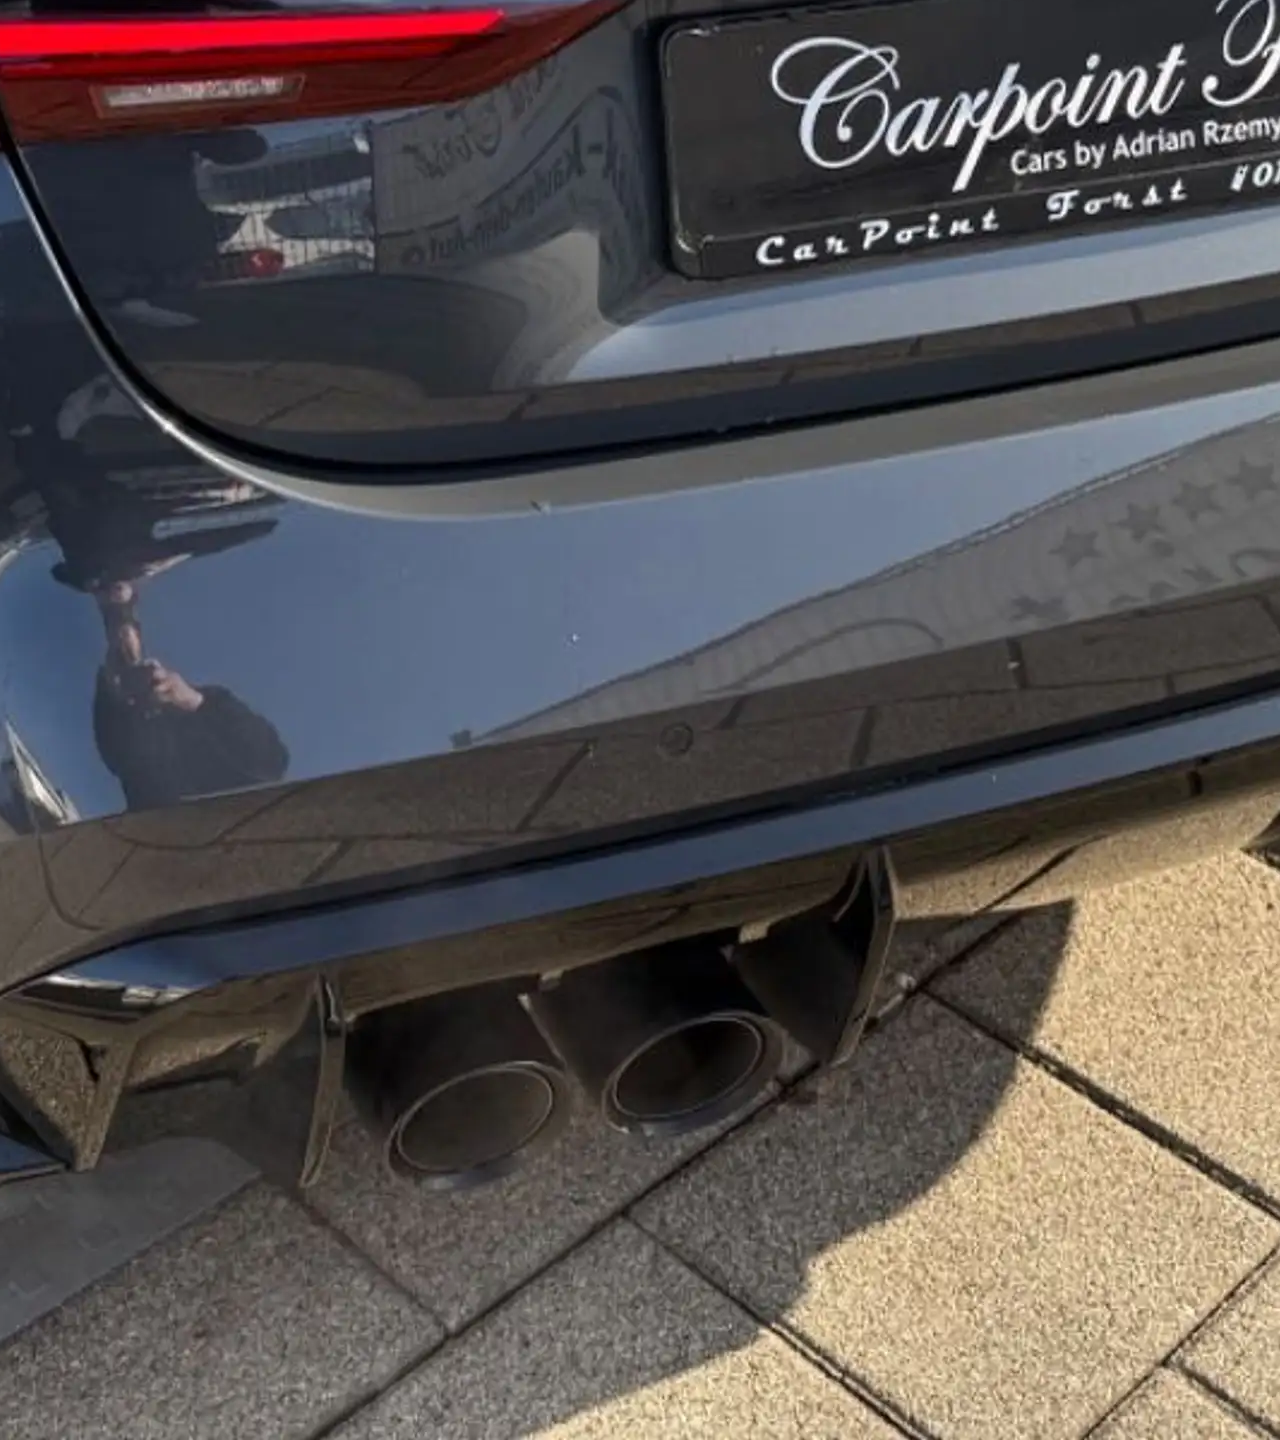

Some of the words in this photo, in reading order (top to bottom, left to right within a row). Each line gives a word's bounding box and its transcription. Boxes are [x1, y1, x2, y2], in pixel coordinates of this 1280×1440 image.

[771, 36, 1186, 192] Carpoint
[1010, 146, 1067, 176] Cars
[1075, 139, 1106, 169] by
[1113, 131, 1197, 162] Adrian
[755, 207, 1001, 266] CarPoint
[1045, 177, 1189, 221] Forst
